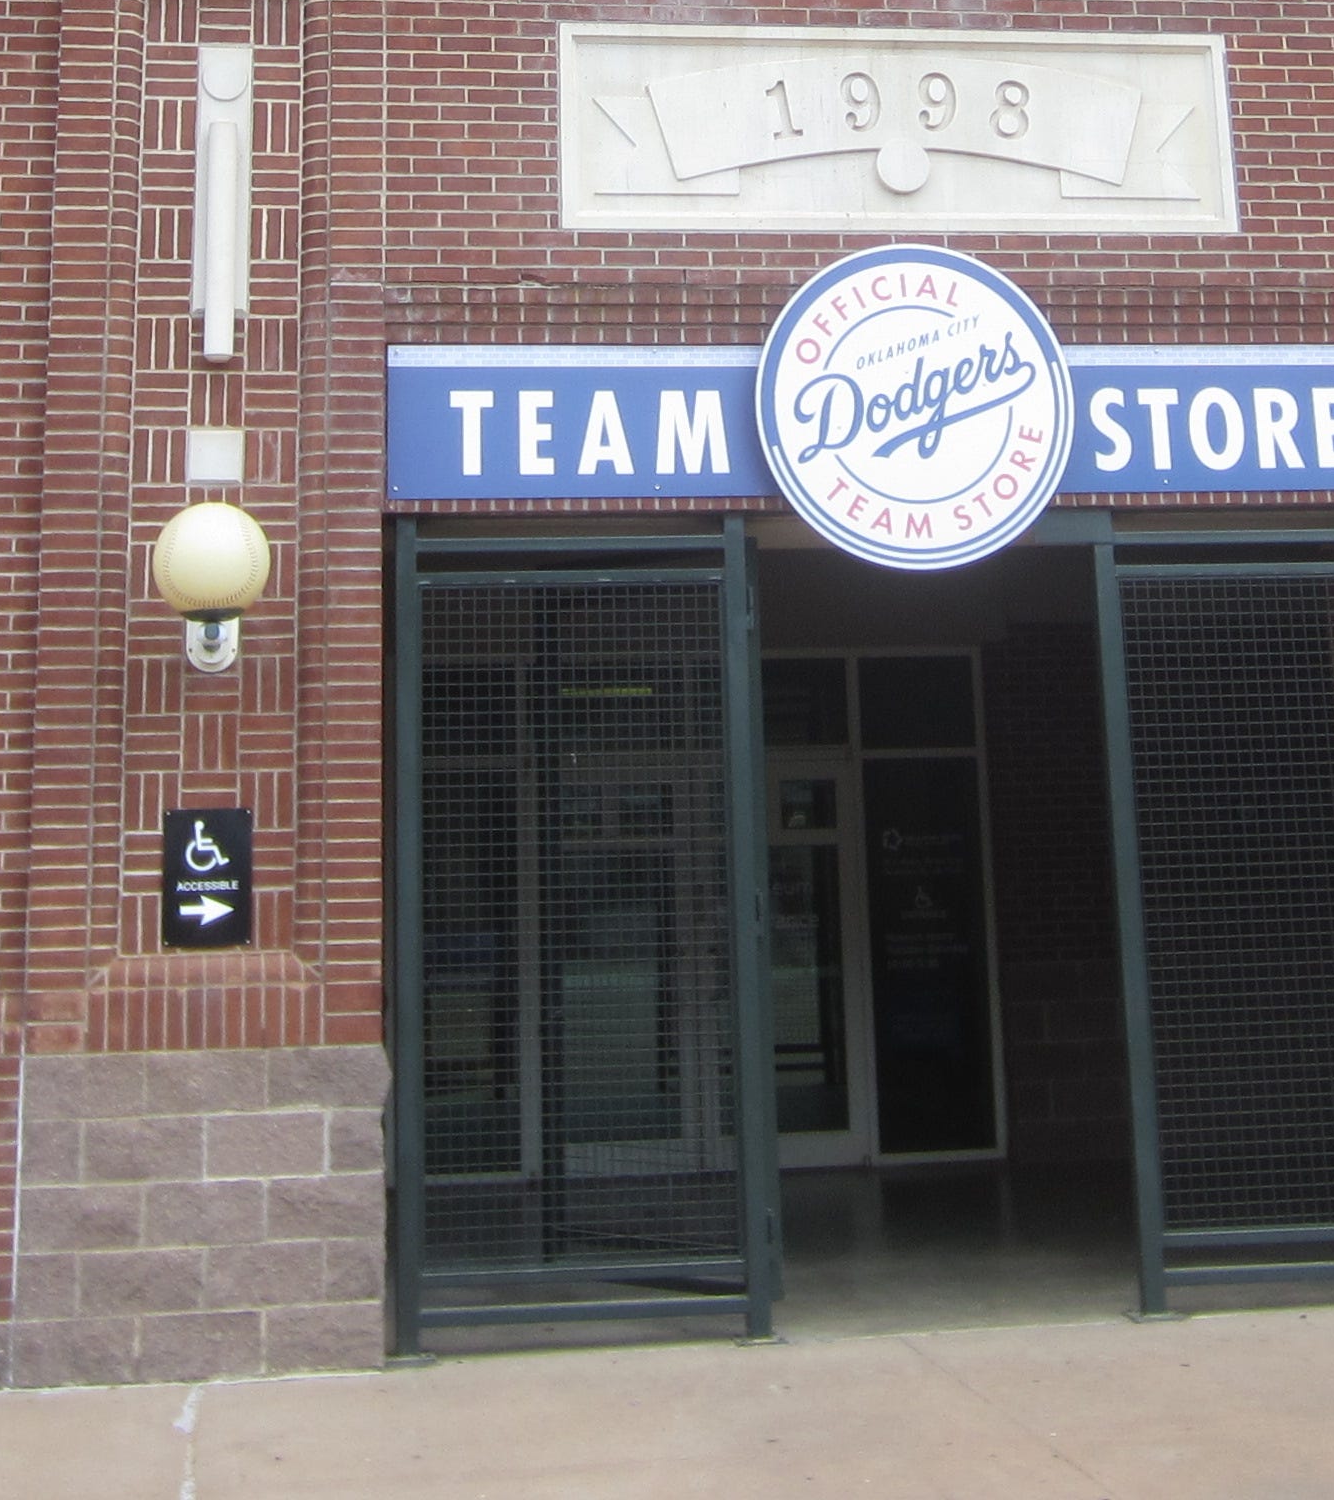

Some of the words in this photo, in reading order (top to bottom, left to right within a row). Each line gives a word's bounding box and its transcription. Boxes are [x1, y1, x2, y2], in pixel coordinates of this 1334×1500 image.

[764, 71, 1030, 140] 1998
[795, 273, 960, 365] OFFICIAL
[856, 329, 940, 371] OKLAHOMA
[947, 314, 981, 338] CITY
[449, 390, 731, 476] TEAM
[793, 331, 1037, 465] Dodgers
[825, 477, 934, 539] TEAM
[953, 424, 1044, 531] STORE
[176, 880, 240, 892] ACCESSIBLE
